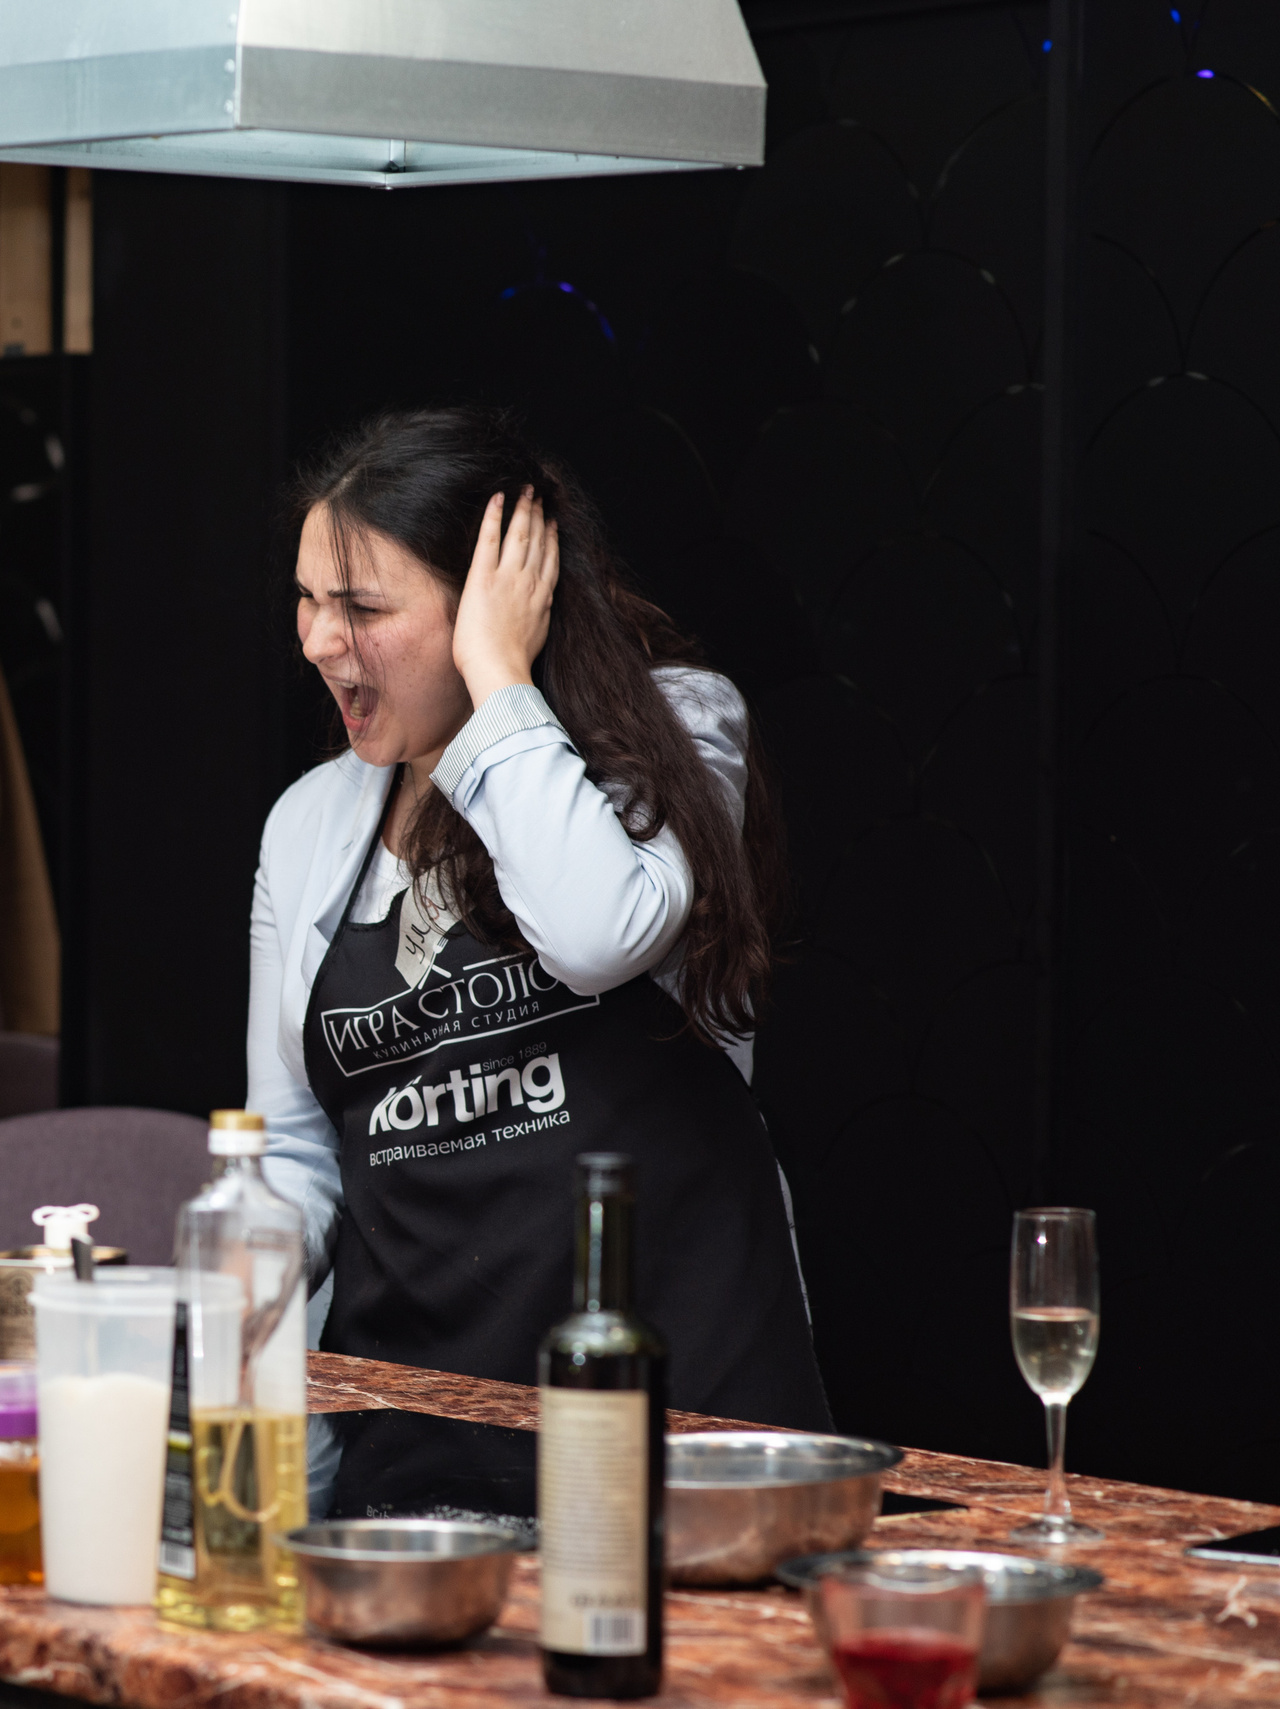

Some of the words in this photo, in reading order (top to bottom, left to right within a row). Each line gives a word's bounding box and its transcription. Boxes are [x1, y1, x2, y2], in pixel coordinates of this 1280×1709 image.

[329, 1005, 420, 1053] ИГРА
[419, 958, 560, 1019] СТОЛО
[373, 1020, 462, 1060] КУЛИНАРНАЯ
[471, 1001, 541, 1028] СТУДИЯ
[482, 1055, 515, 1072] since
[519, 1041, 548, 1061] 1889
[370, 1133, 487, 1167] встраиваемая
[492, 1110, 571, 1141] техника
